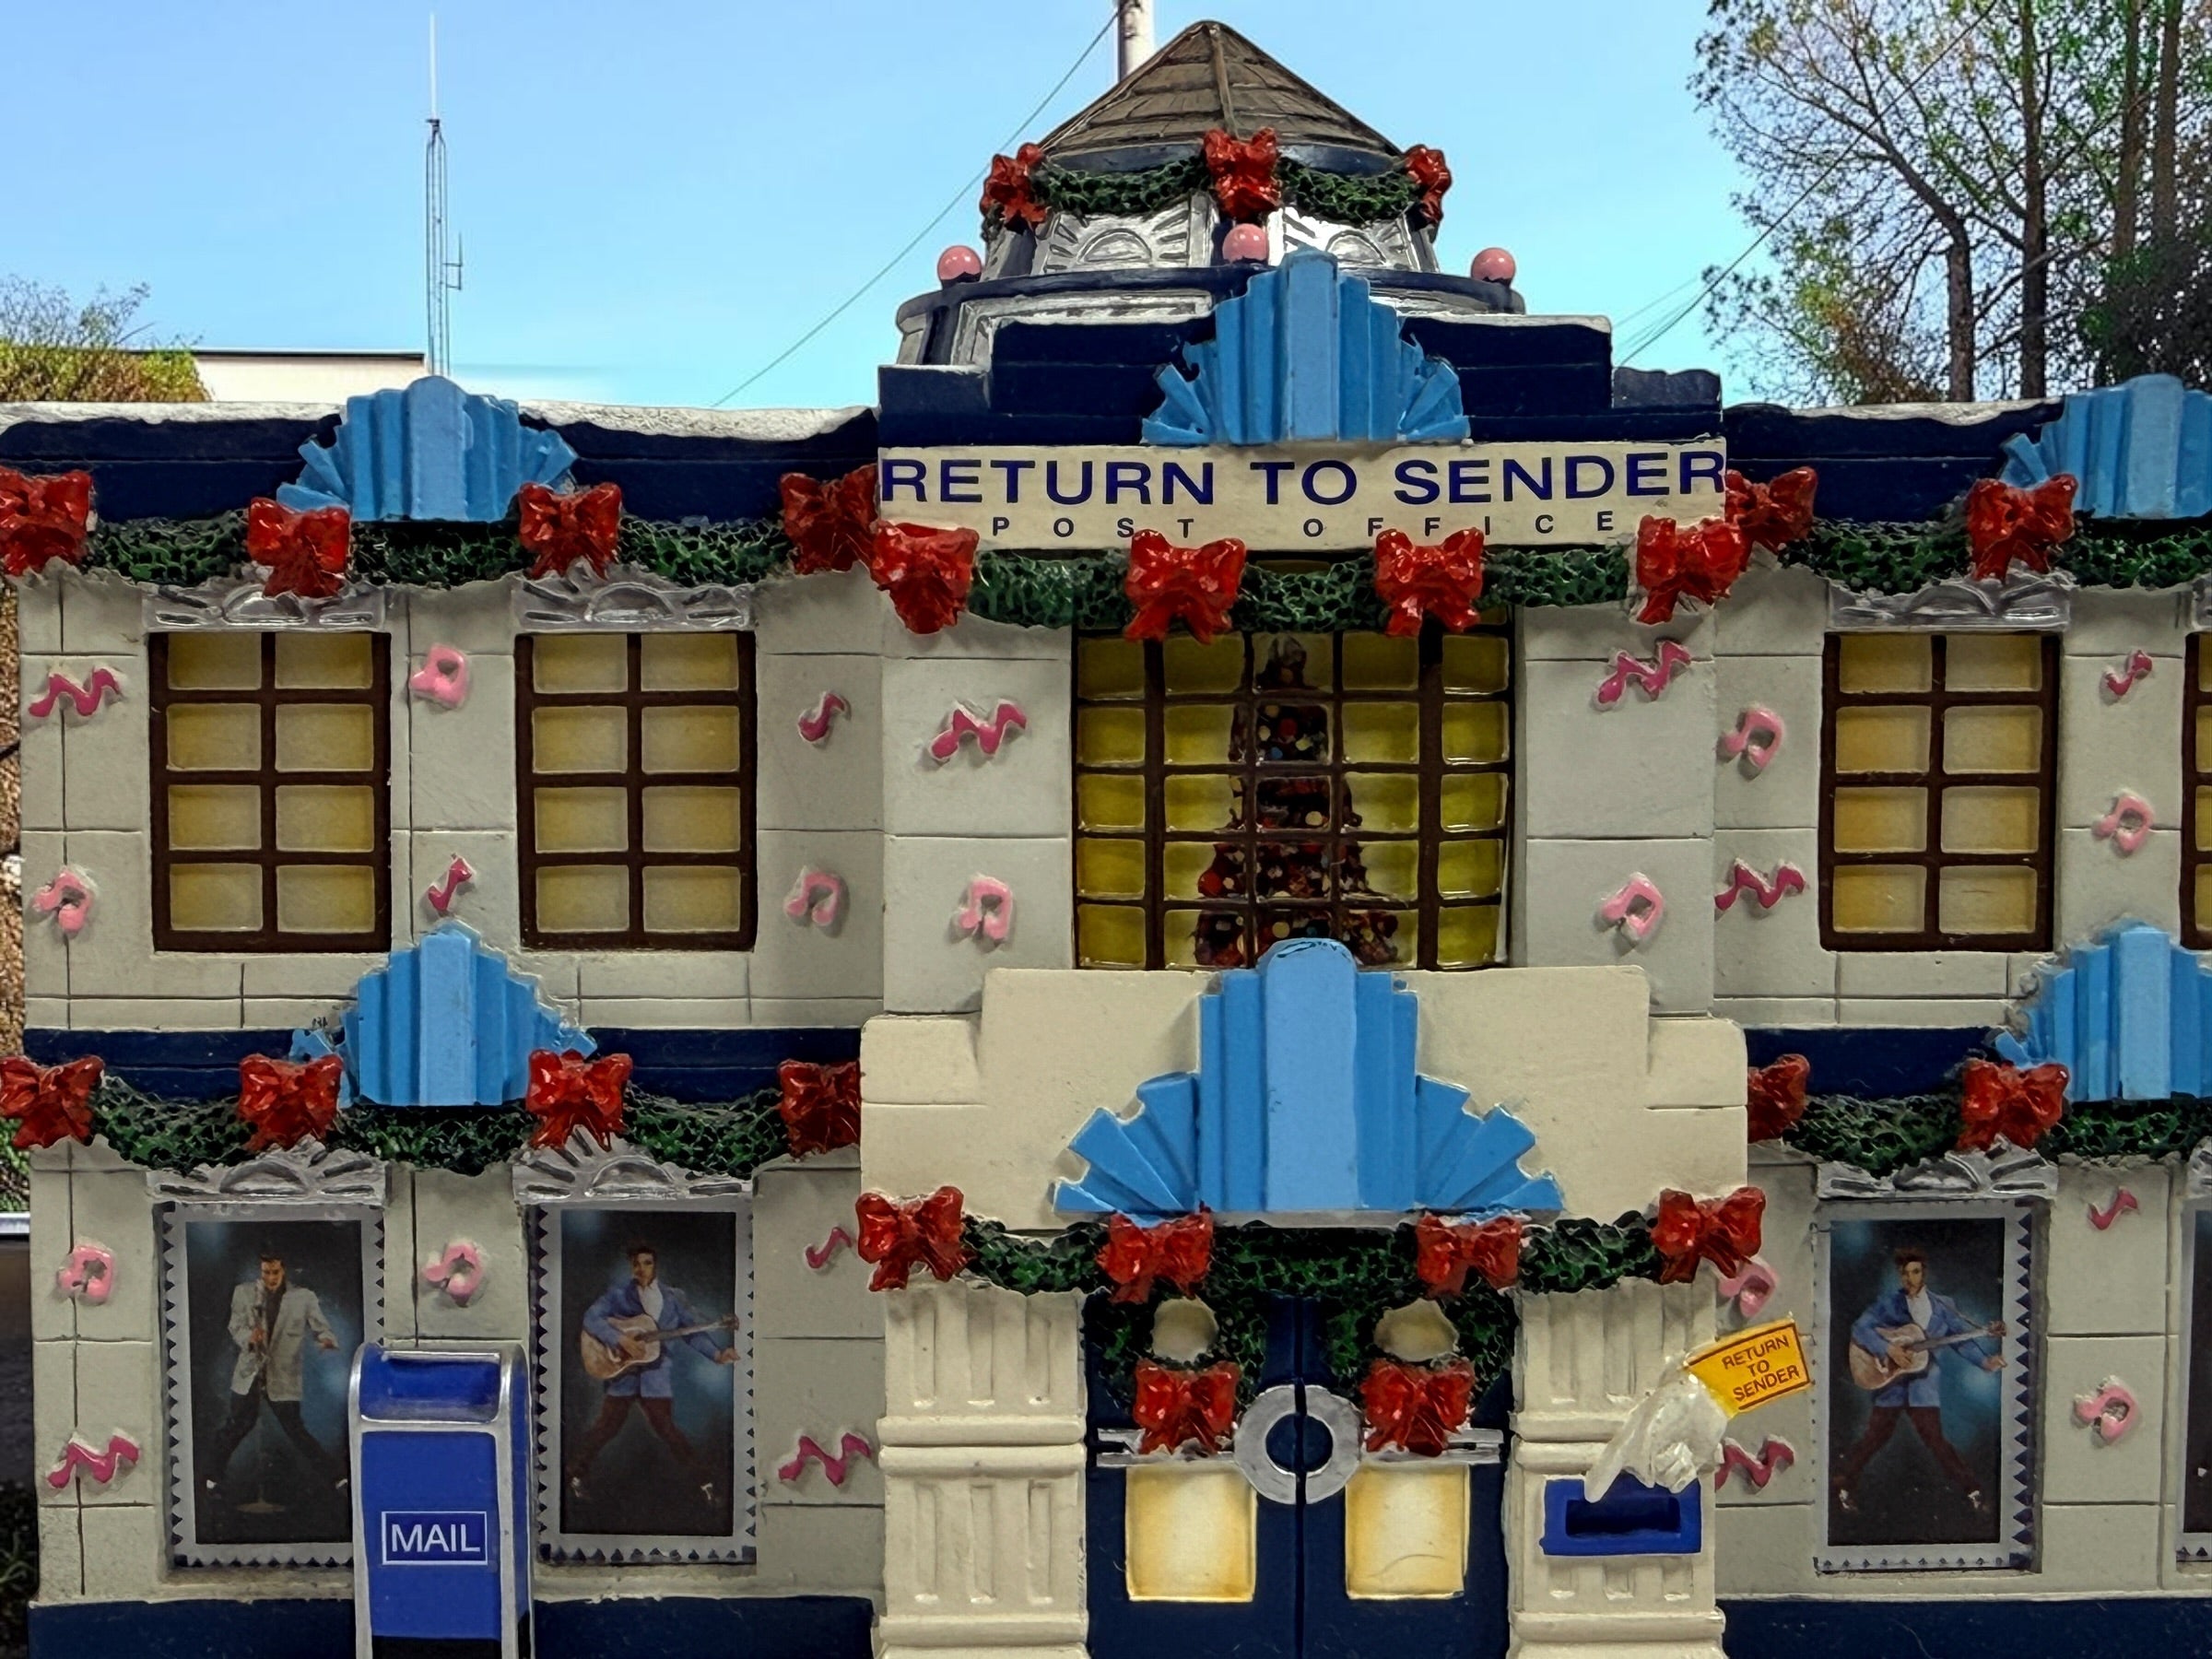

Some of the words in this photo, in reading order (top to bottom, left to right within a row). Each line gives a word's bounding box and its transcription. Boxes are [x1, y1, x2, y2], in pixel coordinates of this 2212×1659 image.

[881, 458, 1213, 505] RETURN
[1250, 460, 1357, 505] TO
[1394, 451, 1725, 505] SENDER
[993, 517, 1194, 538] POST
[1303, 511, 1614, 538] OFFICE
[1723, 1336, 1789, 1370] RETURN
[1747, 1359, 1771, 1376] TO
[1733, 1365, 1800, 1401] SENDER
[391, 1524, 481, 1552] MAIL
